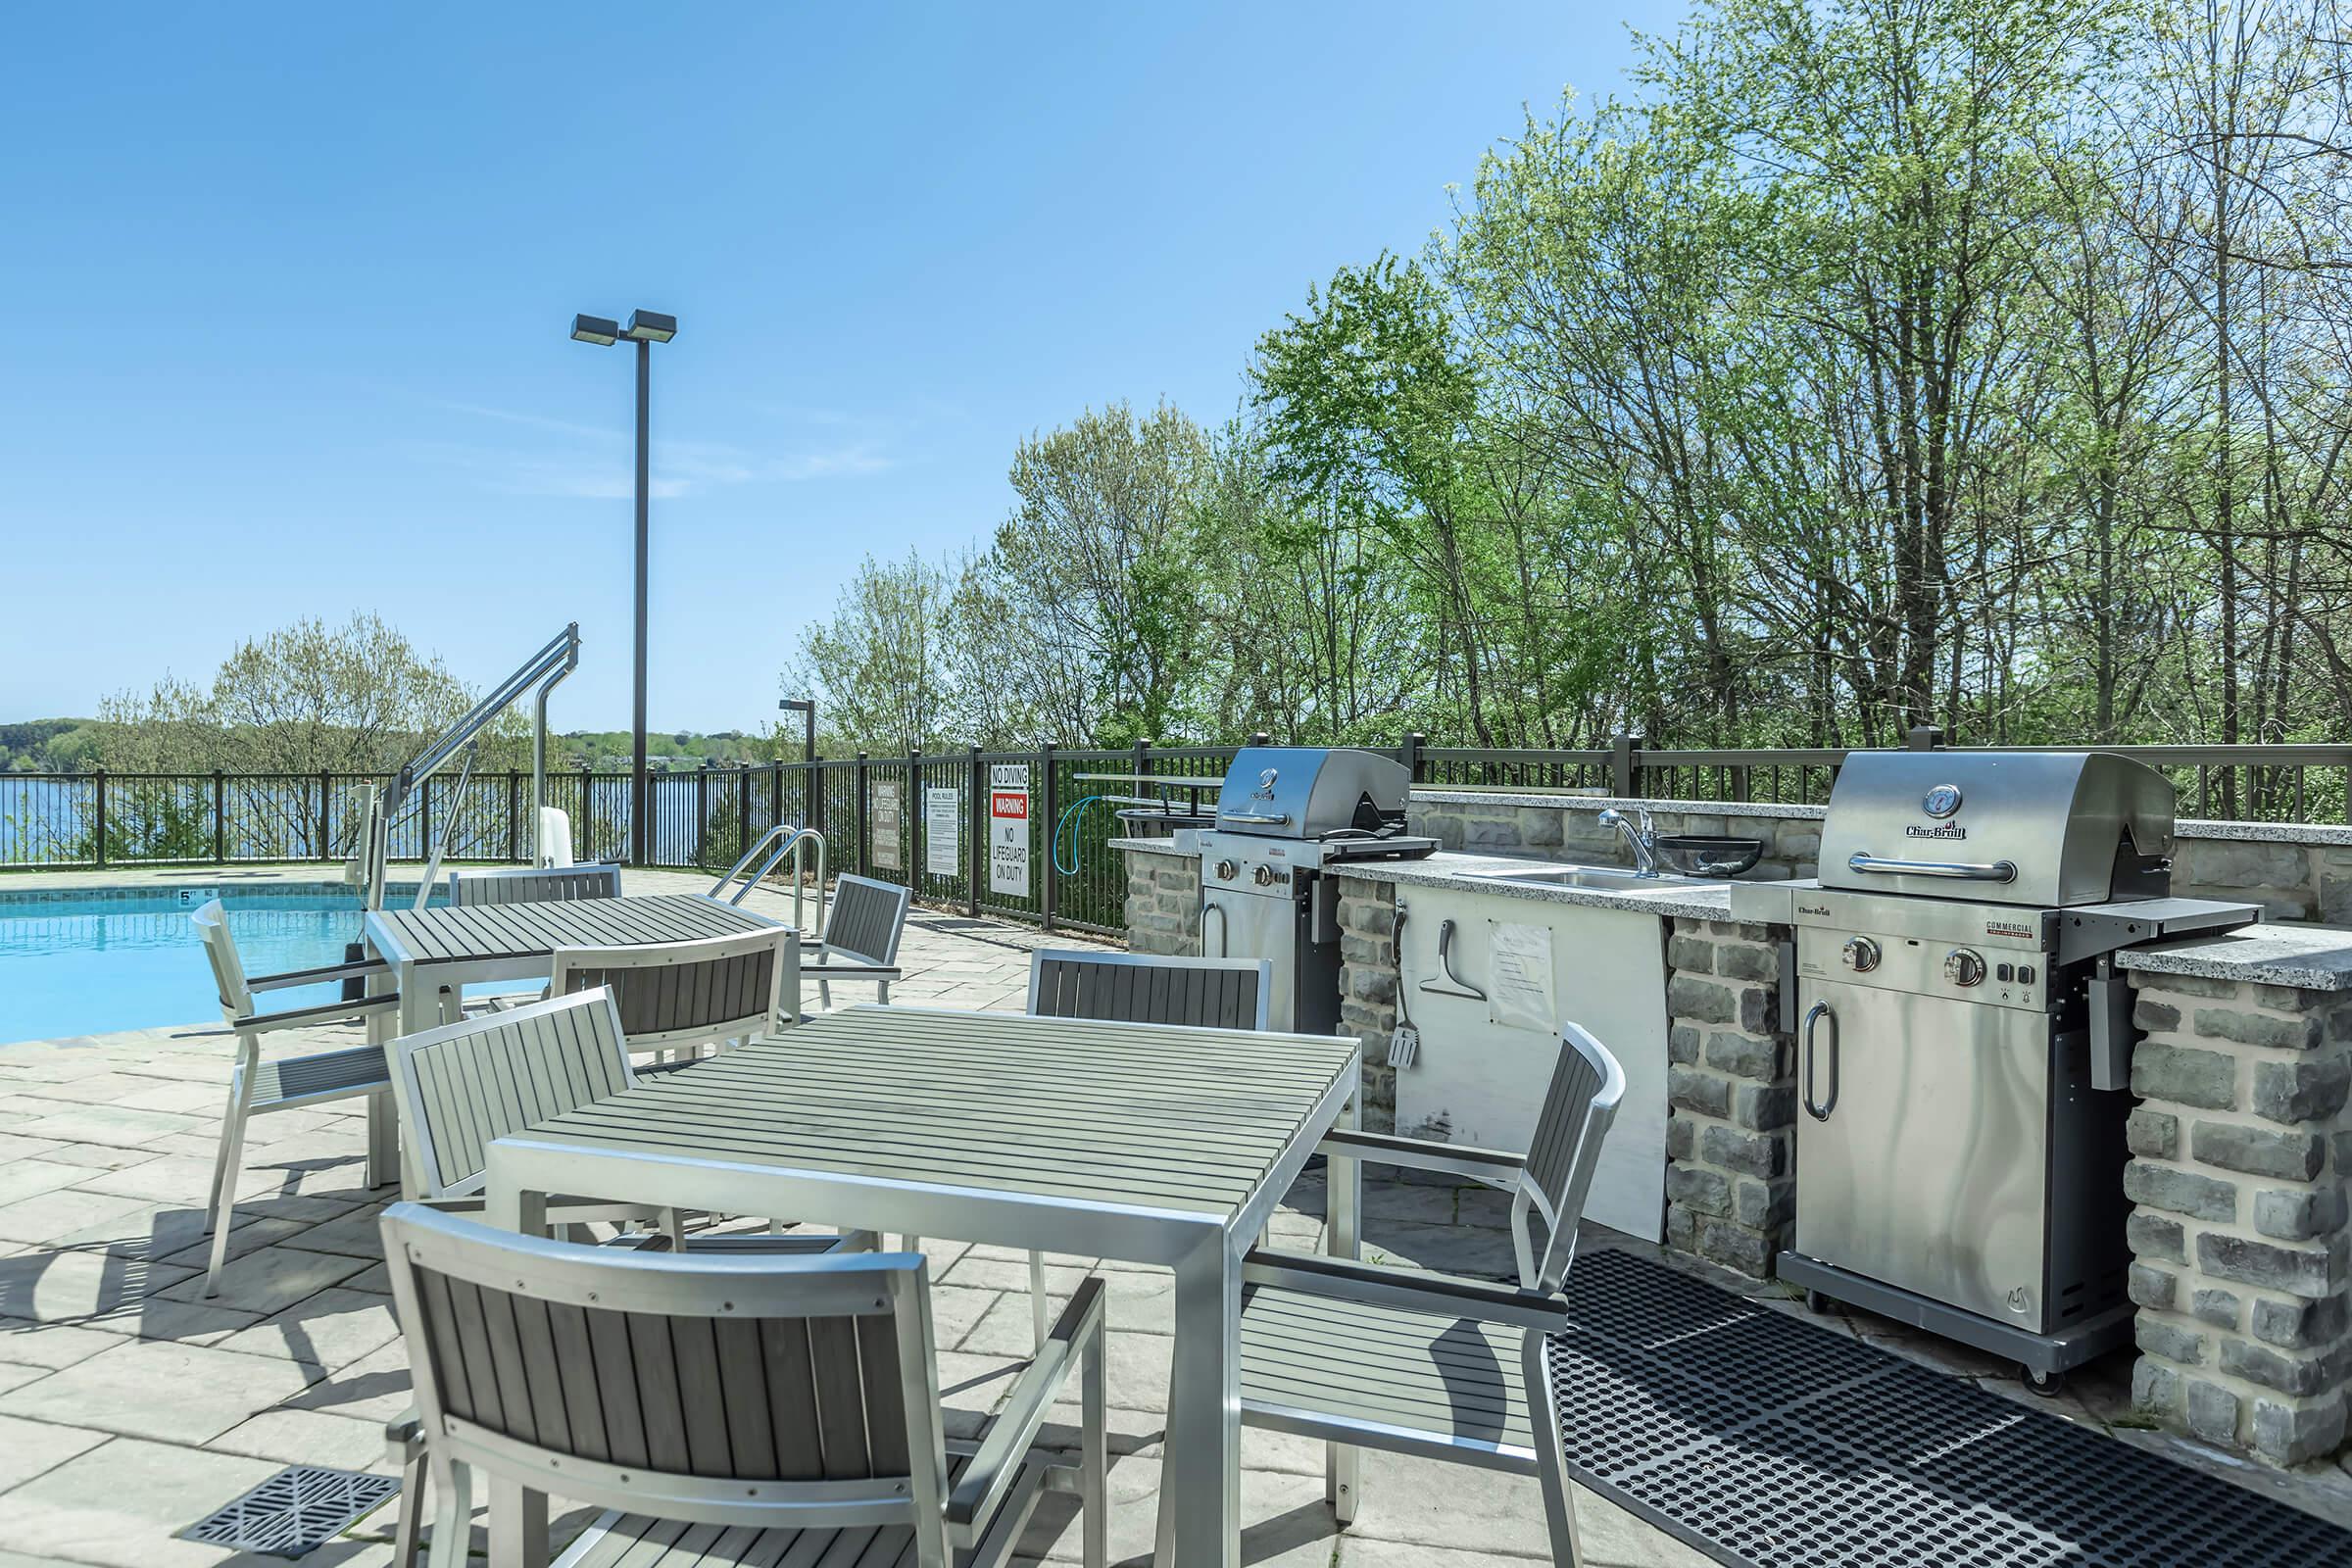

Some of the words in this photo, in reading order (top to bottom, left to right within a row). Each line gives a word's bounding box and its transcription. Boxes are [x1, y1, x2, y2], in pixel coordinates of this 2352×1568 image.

[993, 767, 1003, 784] NO
[1004, 767, 1028, 785] DIVING
[996, 798, 1024, 814] WARNING
[1005, 827, 1013, 843] NO
[1906, 824, 1967, 840] Char-Broil
[993, 846, 1026, 862] LIFEGUARD
[997, 864, 1005, 879] ON
[1006, 866, 1022, 882] DUTY
[180, 891, 189, 901] 5
[1986, 921, 2033, 933] COMMERCIAL
